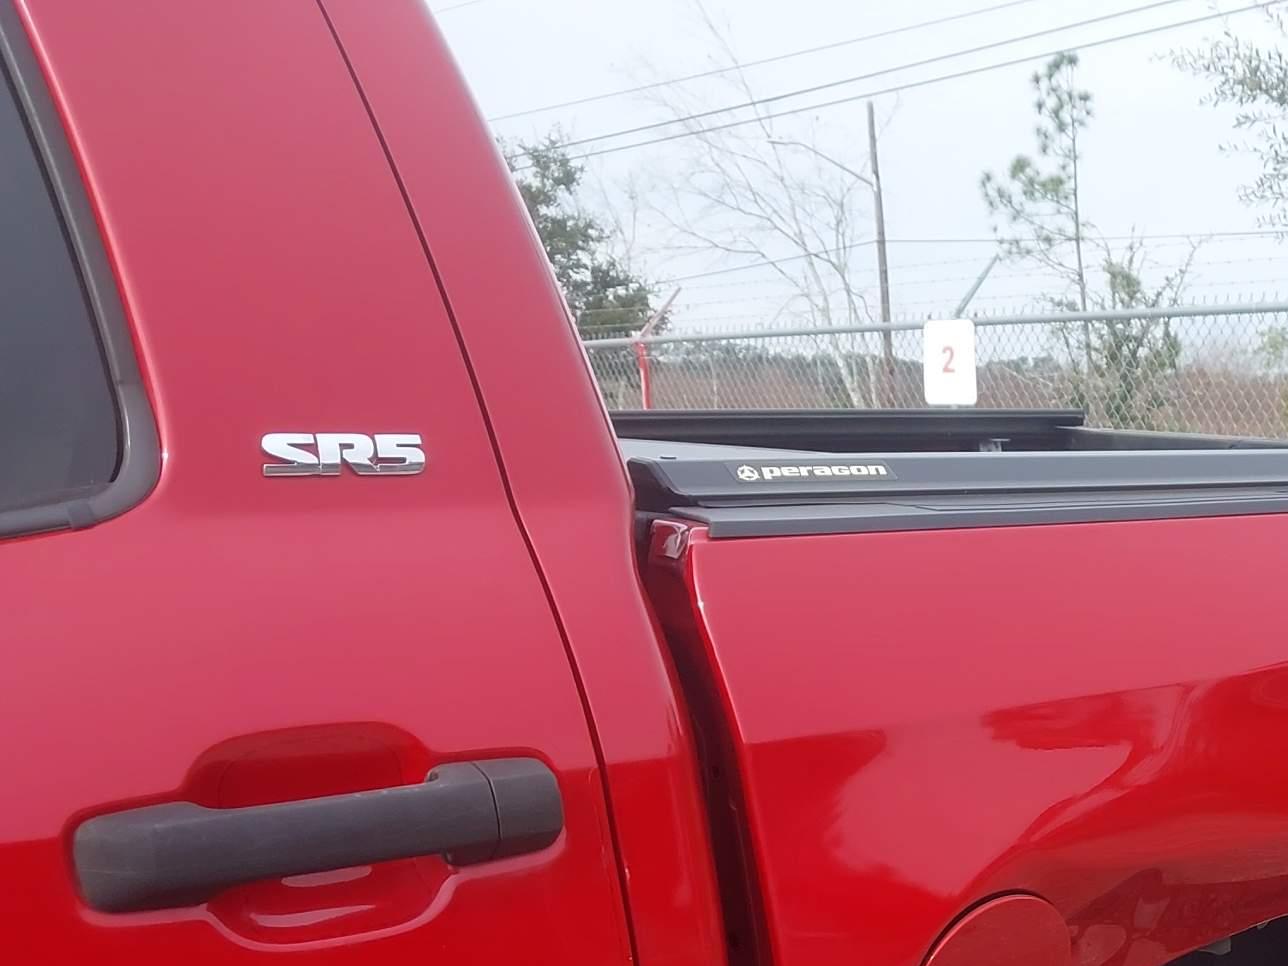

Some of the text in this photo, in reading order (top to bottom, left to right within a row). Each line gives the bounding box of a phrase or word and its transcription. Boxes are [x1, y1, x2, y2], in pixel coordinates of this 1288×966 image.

[941, 345, 955, 373] 2
[261, 433, 426, 477] SR5
[761, 465, 888, 480] peragon
